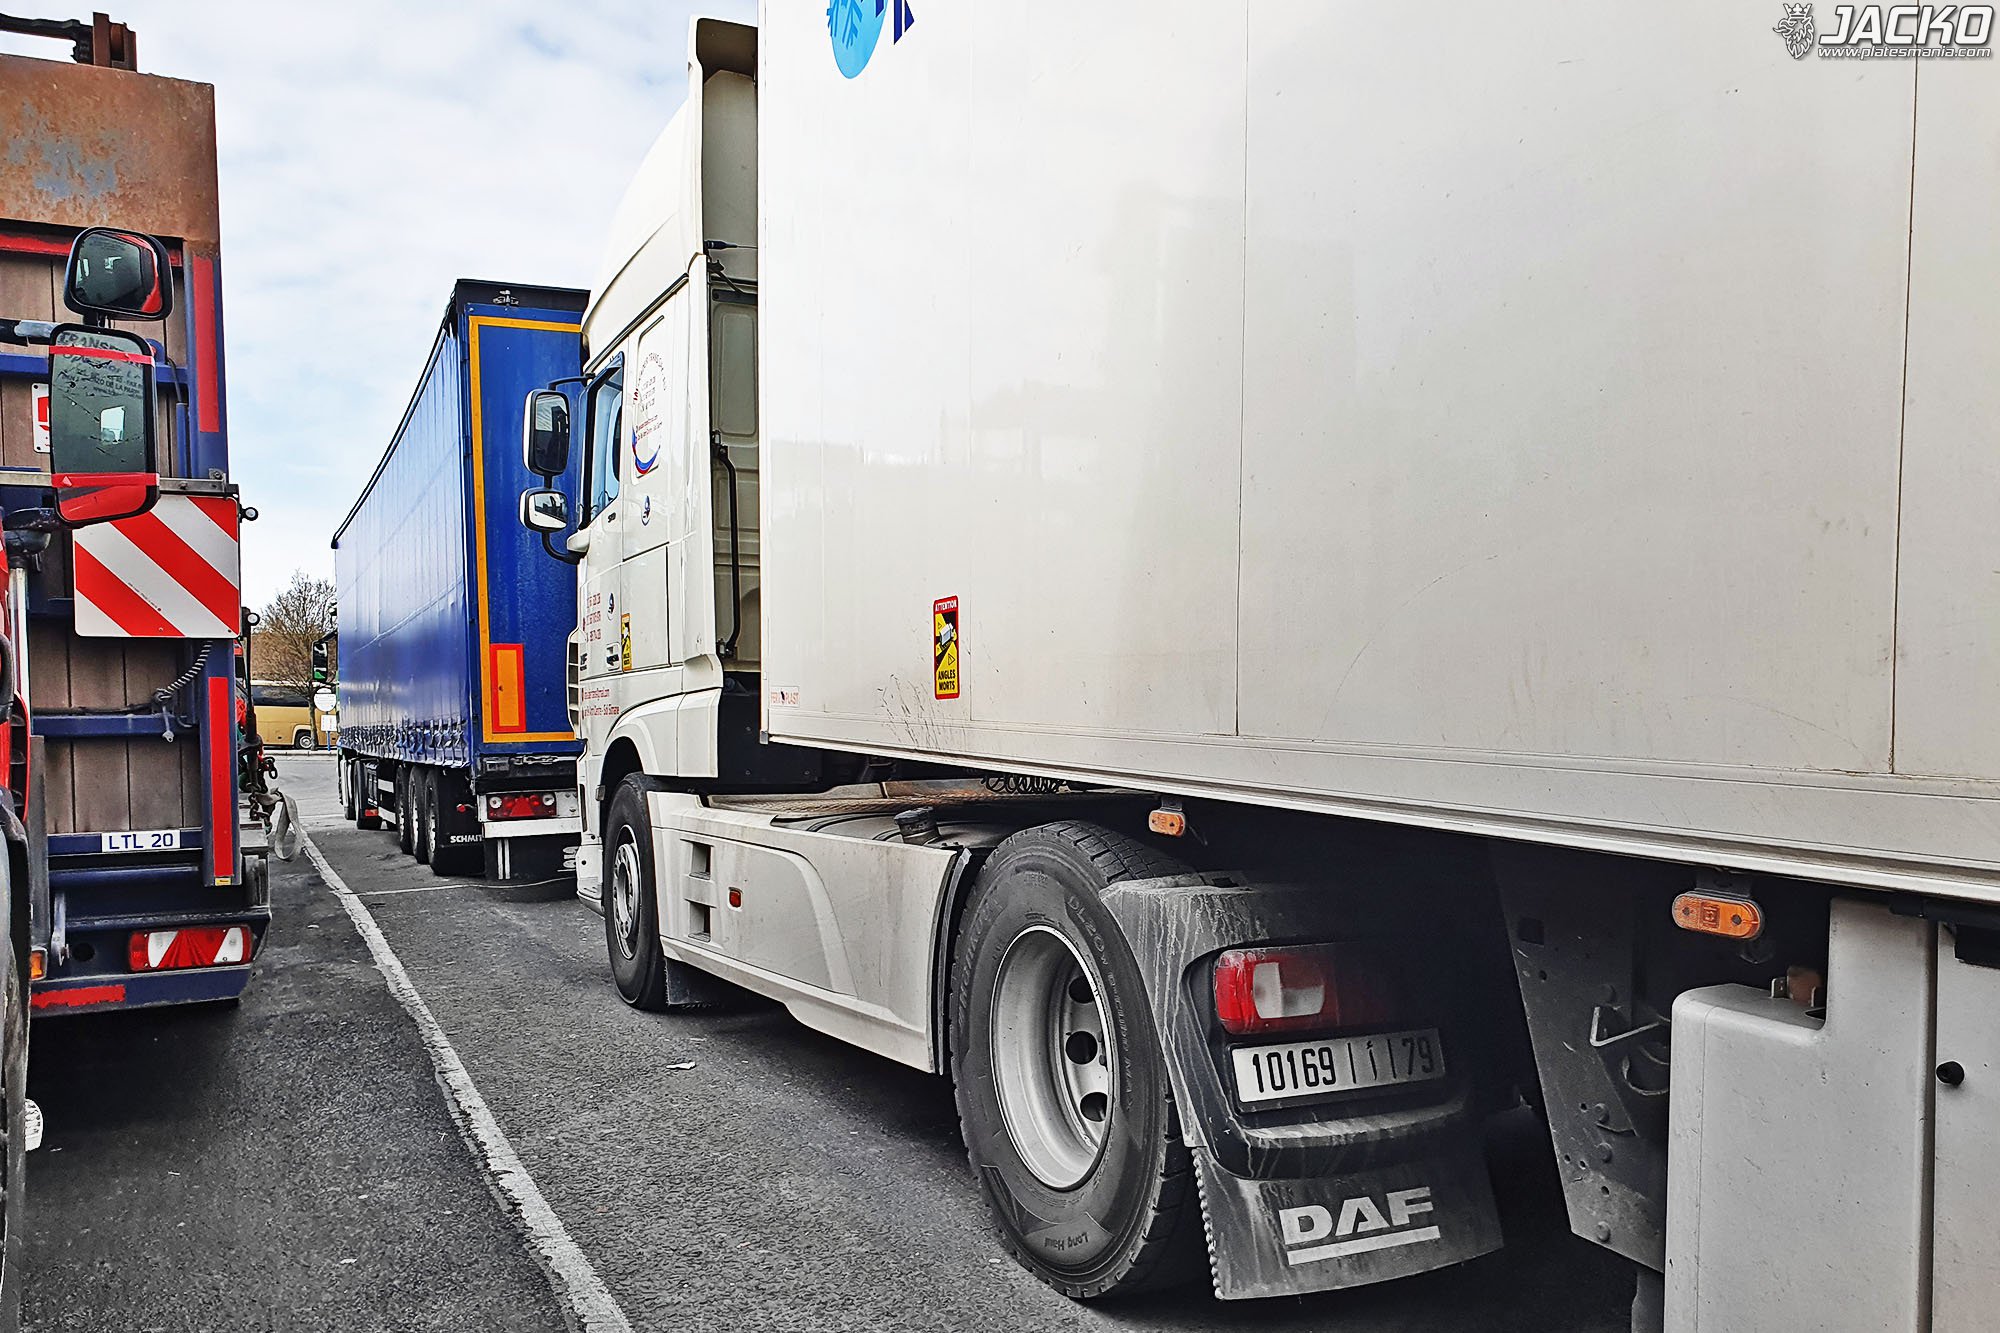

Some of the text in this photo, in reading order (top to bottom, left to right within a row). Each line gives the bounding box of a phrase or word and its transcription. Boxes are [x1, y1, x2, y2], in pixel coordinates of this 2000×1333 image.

[938, 669, 956, 681] ANGLES
[938, 680, 956, 691] MORTS
[108, 833, 173, 849] LTL 20
[450, 834, 484, 844] SCHMIT
[1252, 1046, 1337, 1093] 10169
[1401, 1036, 1435, 1076] 79
[1278, 1186, 1434, 1245] DAF
